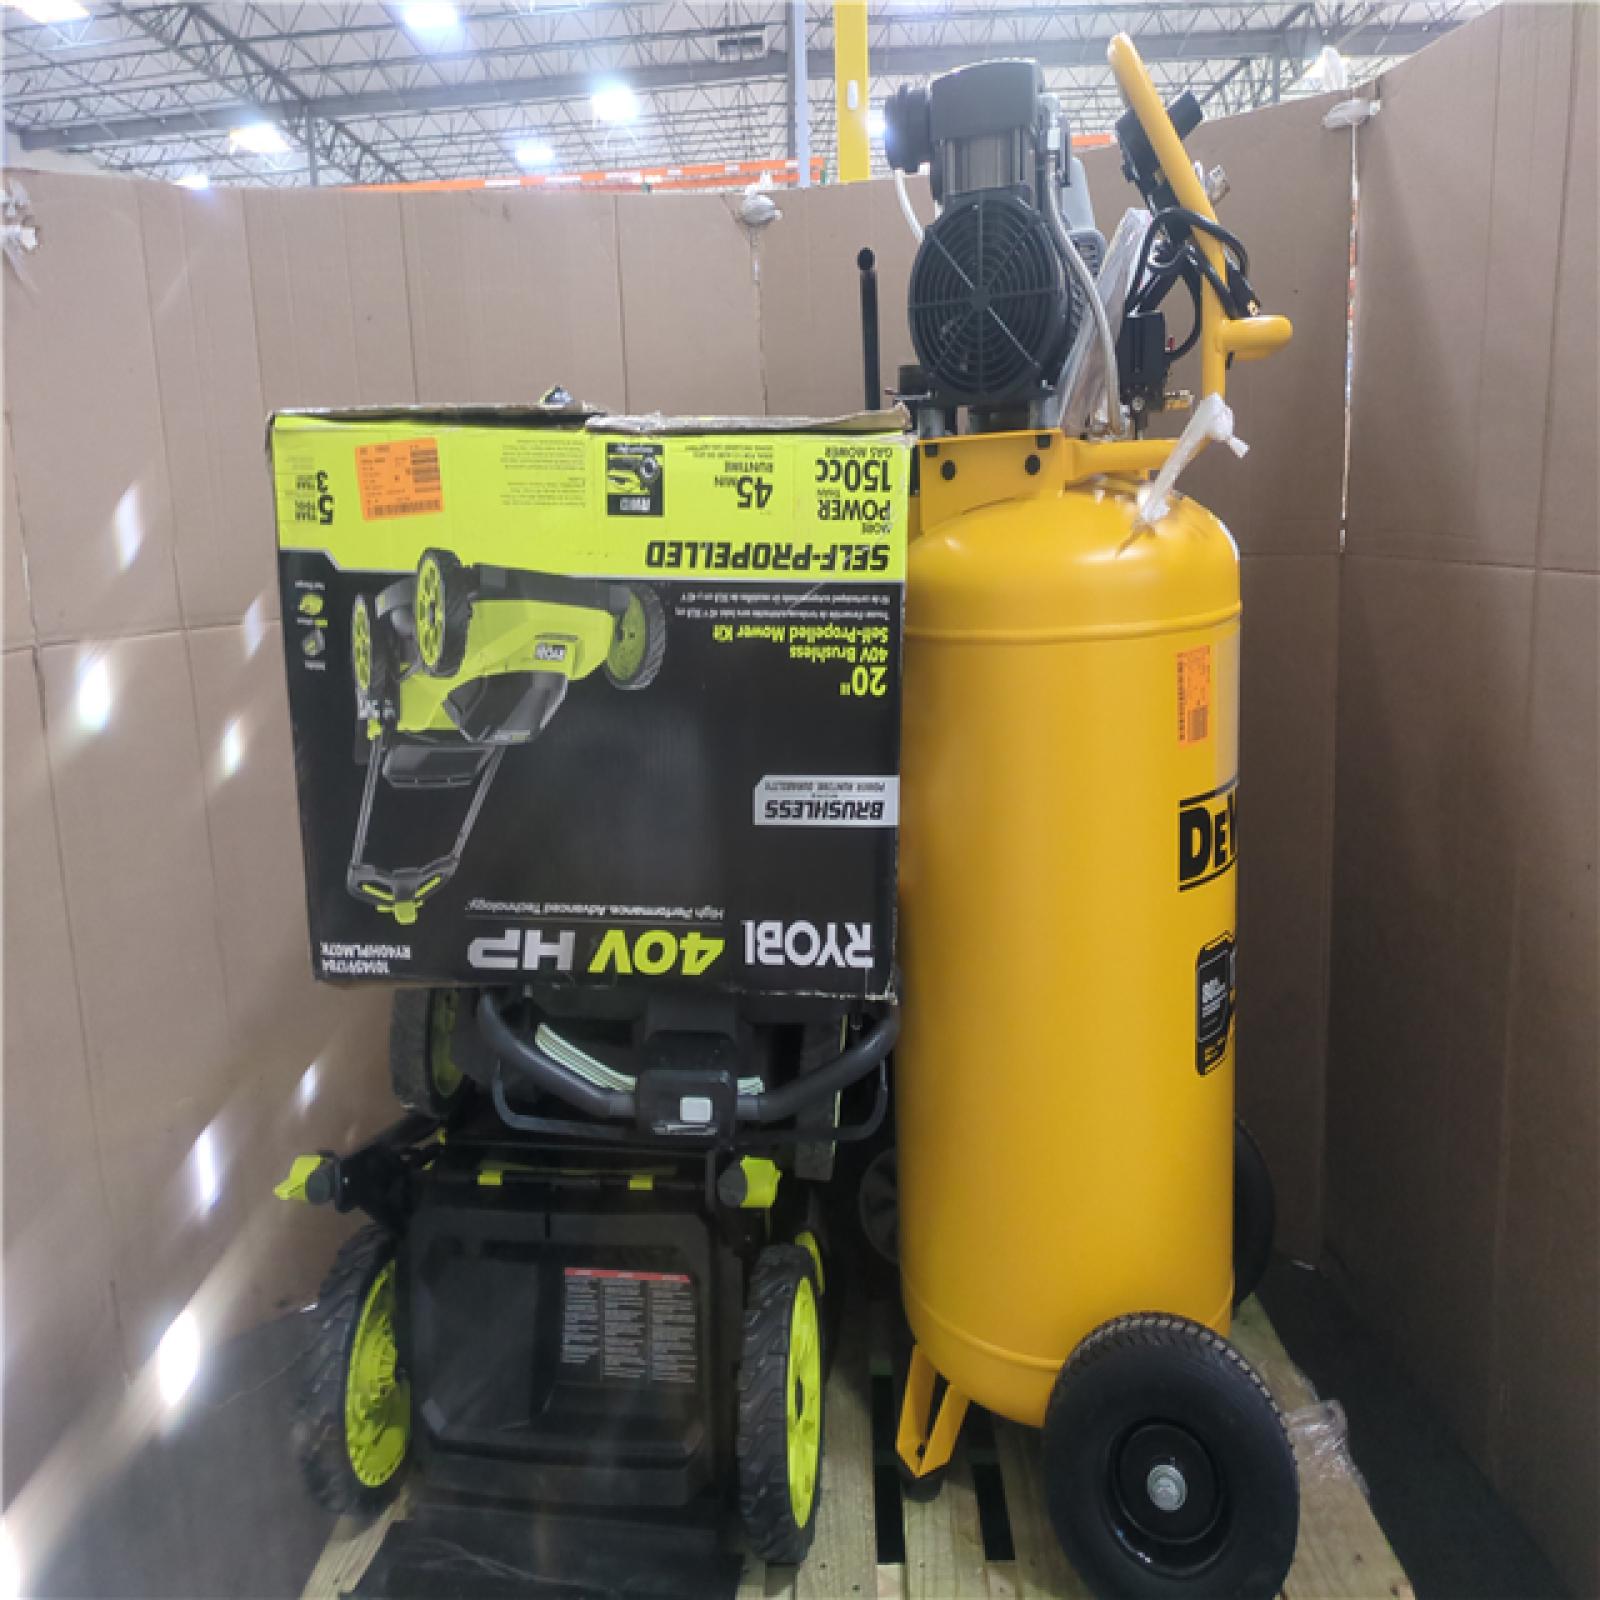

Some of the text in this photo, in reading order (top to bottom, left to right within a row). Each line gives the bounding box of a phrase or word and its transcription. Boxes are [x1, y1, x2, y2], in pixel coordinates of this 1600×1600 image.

[725, 461, 774, 473] RUNTIME
[814, 459, 893, 493] 150cc
[316, 470, 329, 493] 3
[736, 476, 773, 508] 45
[317, 494, 335, 526] 5
[817, 499, 891, 520] POWER
[645, 540, 890, 571] SELF-PROPELLED
[712, 623, 889, 644] Self-Propelled Mower Kit
[790, 644, 856, 663] Brushless
[765, 800, 885, 820] BRUSHLESS
[465, 920, 874, 975] RYOBI 40V HP
